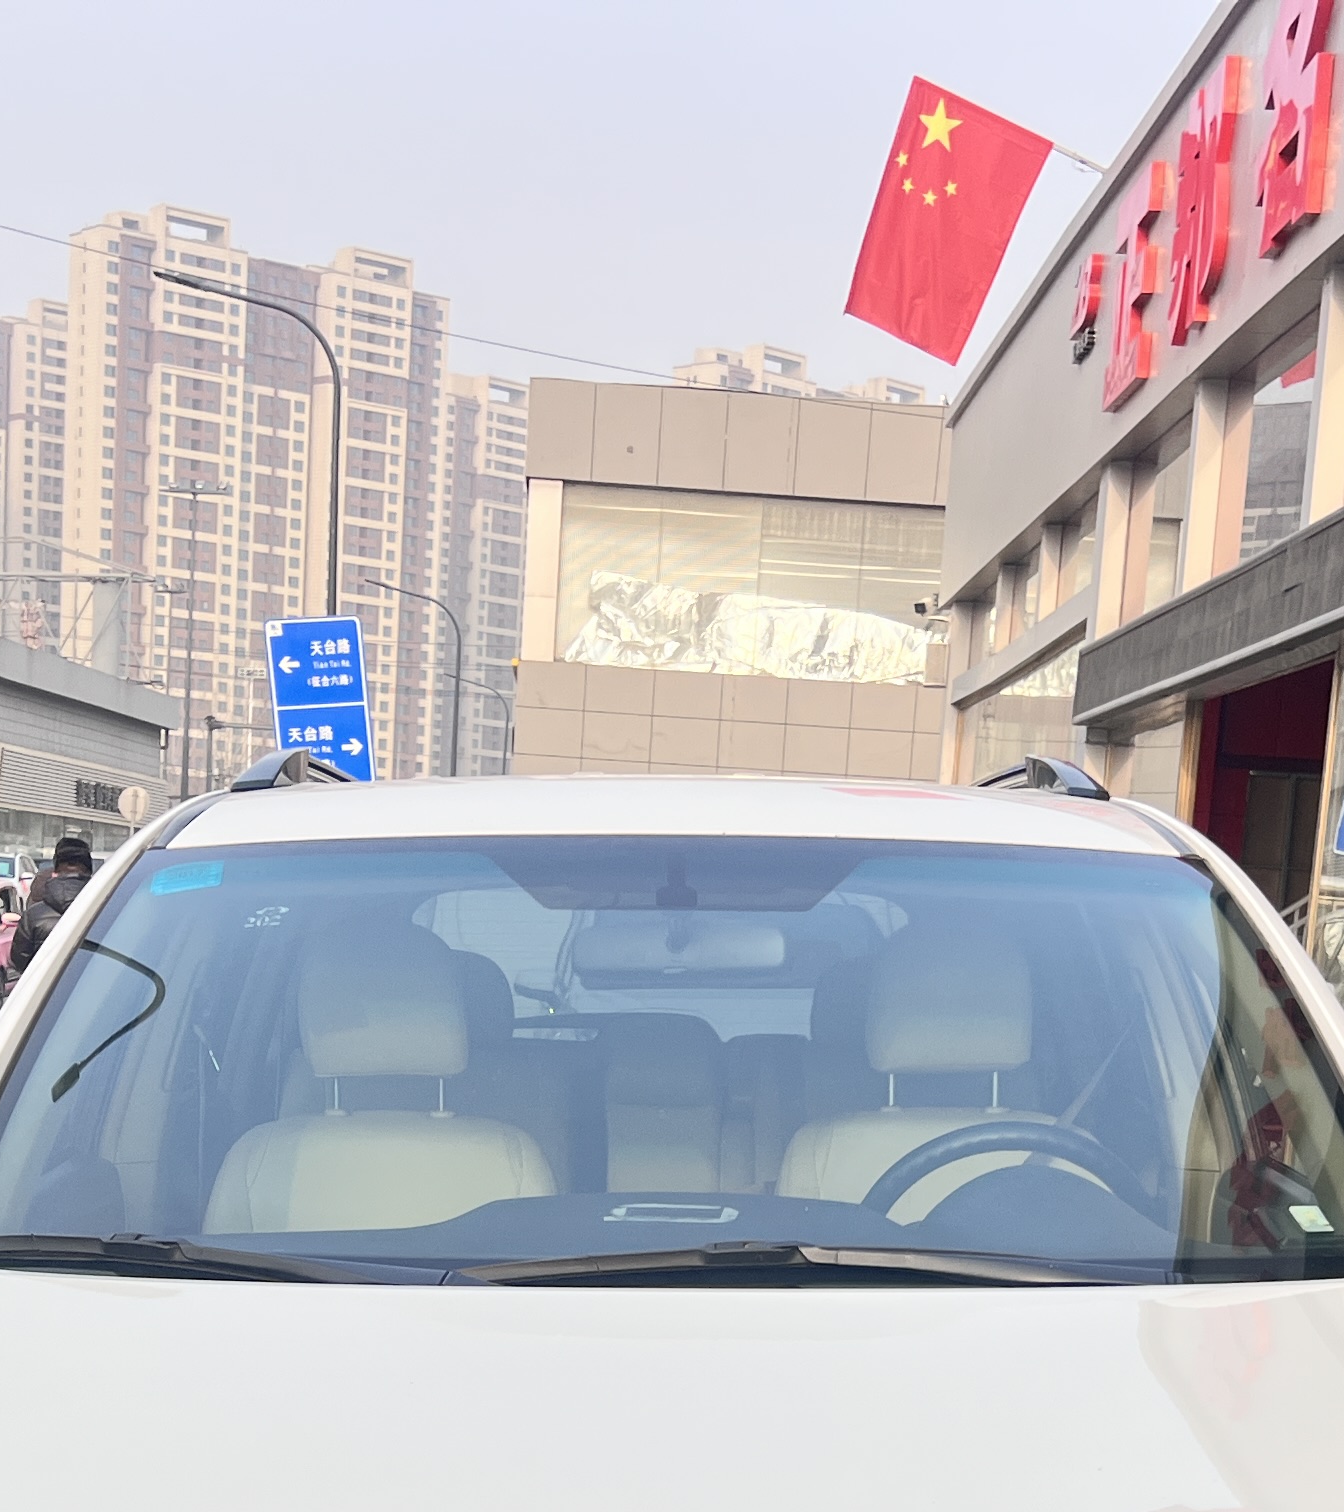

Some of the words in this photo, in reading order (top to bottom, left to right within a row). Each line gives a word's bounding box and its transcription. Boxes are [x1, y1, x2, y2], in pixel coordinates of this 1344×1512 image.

[309, 638, 351, 656] 天台路
[287, 725, 334, 743] 天台路
